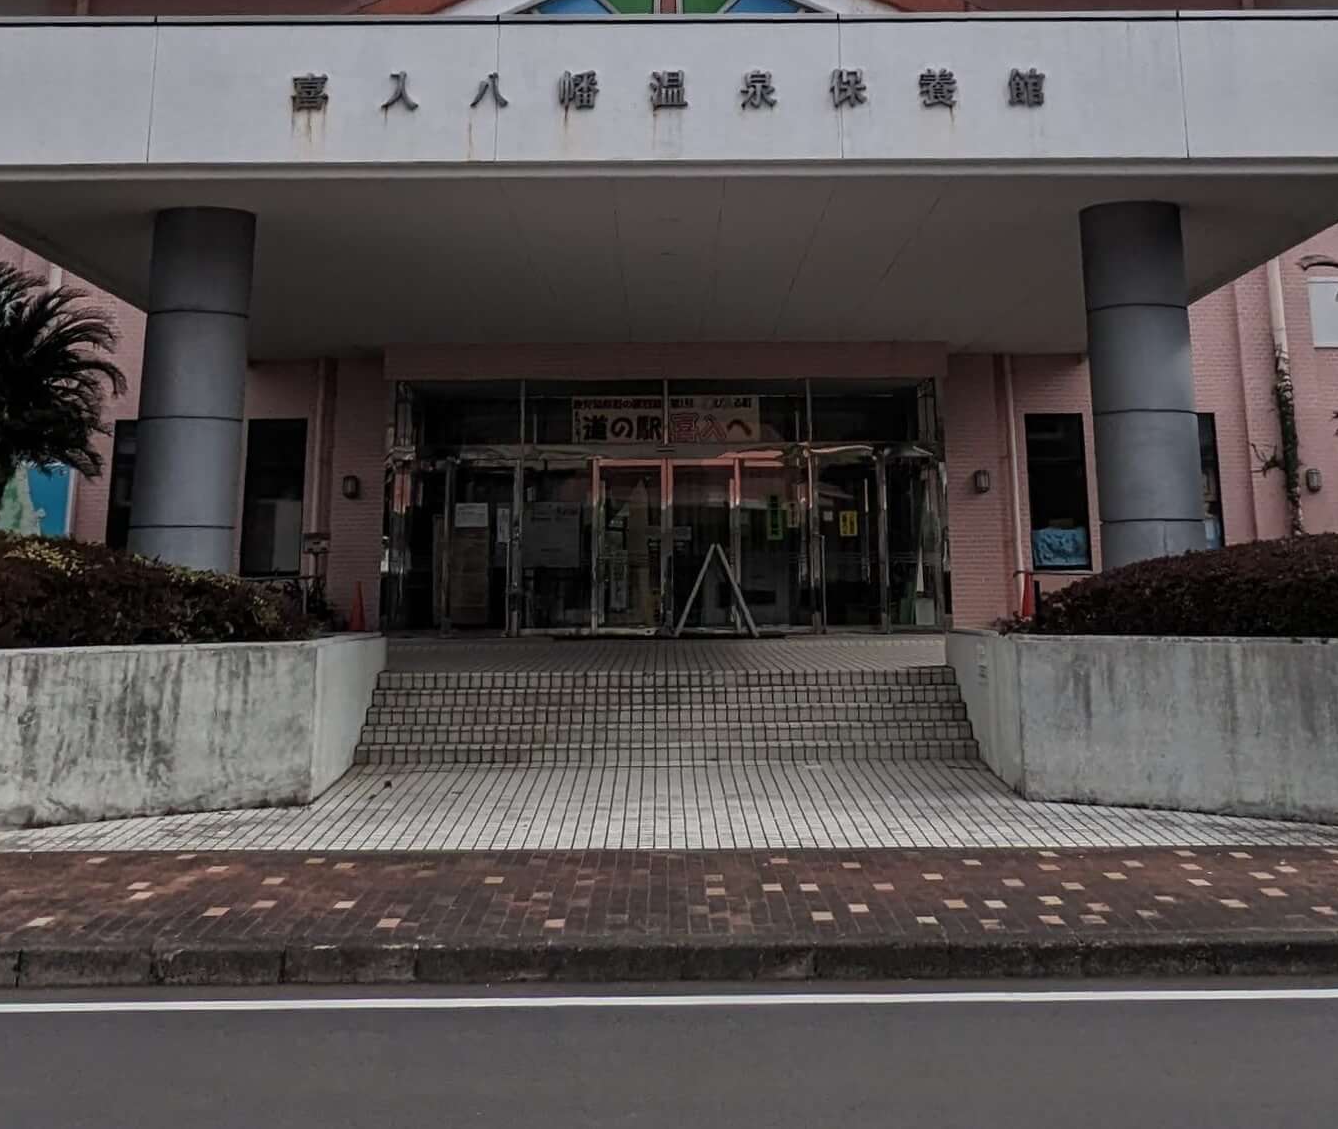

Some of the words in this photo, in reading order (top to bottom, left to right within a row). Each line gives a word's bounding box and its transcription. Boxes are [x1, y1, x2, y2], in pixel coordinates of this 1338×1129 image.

[290, 69, 1046, 112] 喜入八幡温泉保養館
